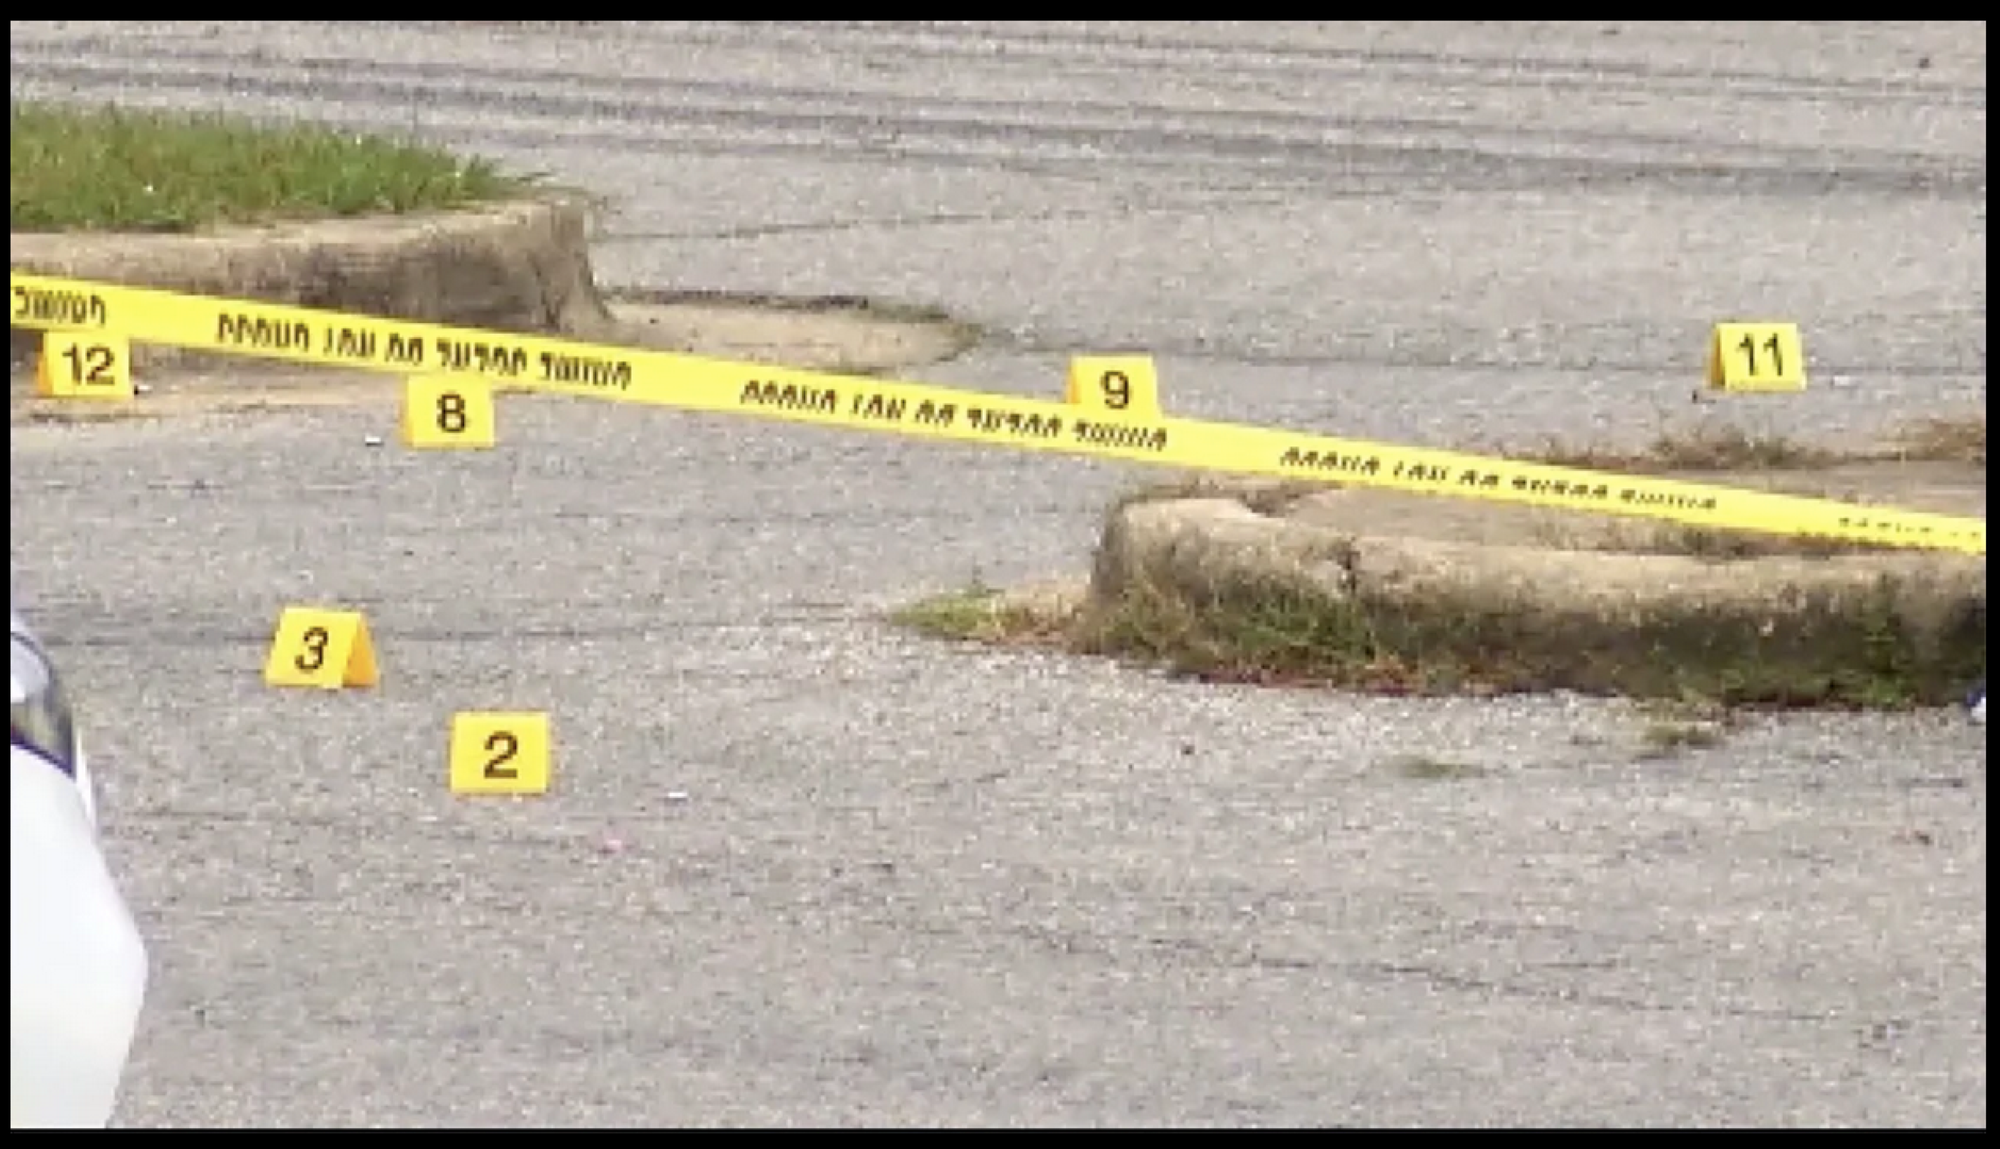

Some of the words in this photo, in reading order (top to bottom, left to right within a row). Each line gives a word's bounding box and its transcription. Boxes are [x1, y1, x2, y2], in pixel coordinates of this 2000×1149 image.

[62, 342, 115, 386] 12
[1736, 332, 1783, 377] 11
[1101, 369, 1130, 410] 9
[436, 393, 467, 433] 8
[295, 626, 330, 673] 3
[483, 730, 519, 779] 2
